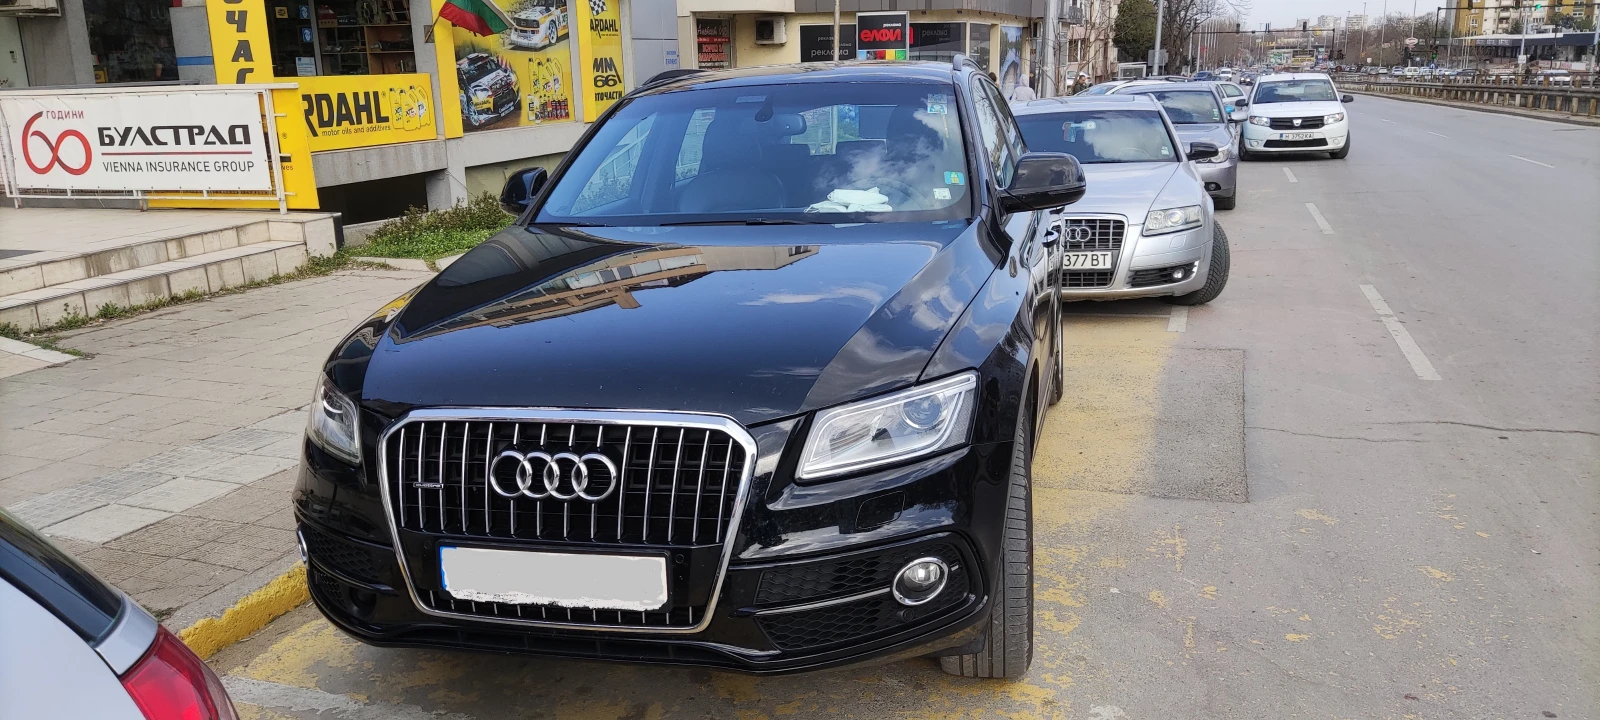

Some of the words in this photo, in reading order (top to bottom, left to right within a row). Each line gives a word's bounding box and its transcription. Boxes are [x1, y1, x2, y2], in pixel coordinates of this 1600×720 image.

[594, 74, 618, 88] 66
[46, 110, 84, 120] ГОДИНИ
[98, 124, 252, 146] БУЛСТРАД
[321, 128, 340, 137] motor
[341, 127, 353, 135] oils
[353, 125, 365, 134] and
[366, 124, 391, 132] additives
[22, 111, 92, 175] 60
[102, 161, 144, 172] VIENNA
[146, 160, 211, 172] INSURANCE
[213, 160, 255, 172] GROUP
[1064, 254, 1088, 267] 377
[1091, 254, 1109, 267] BT
